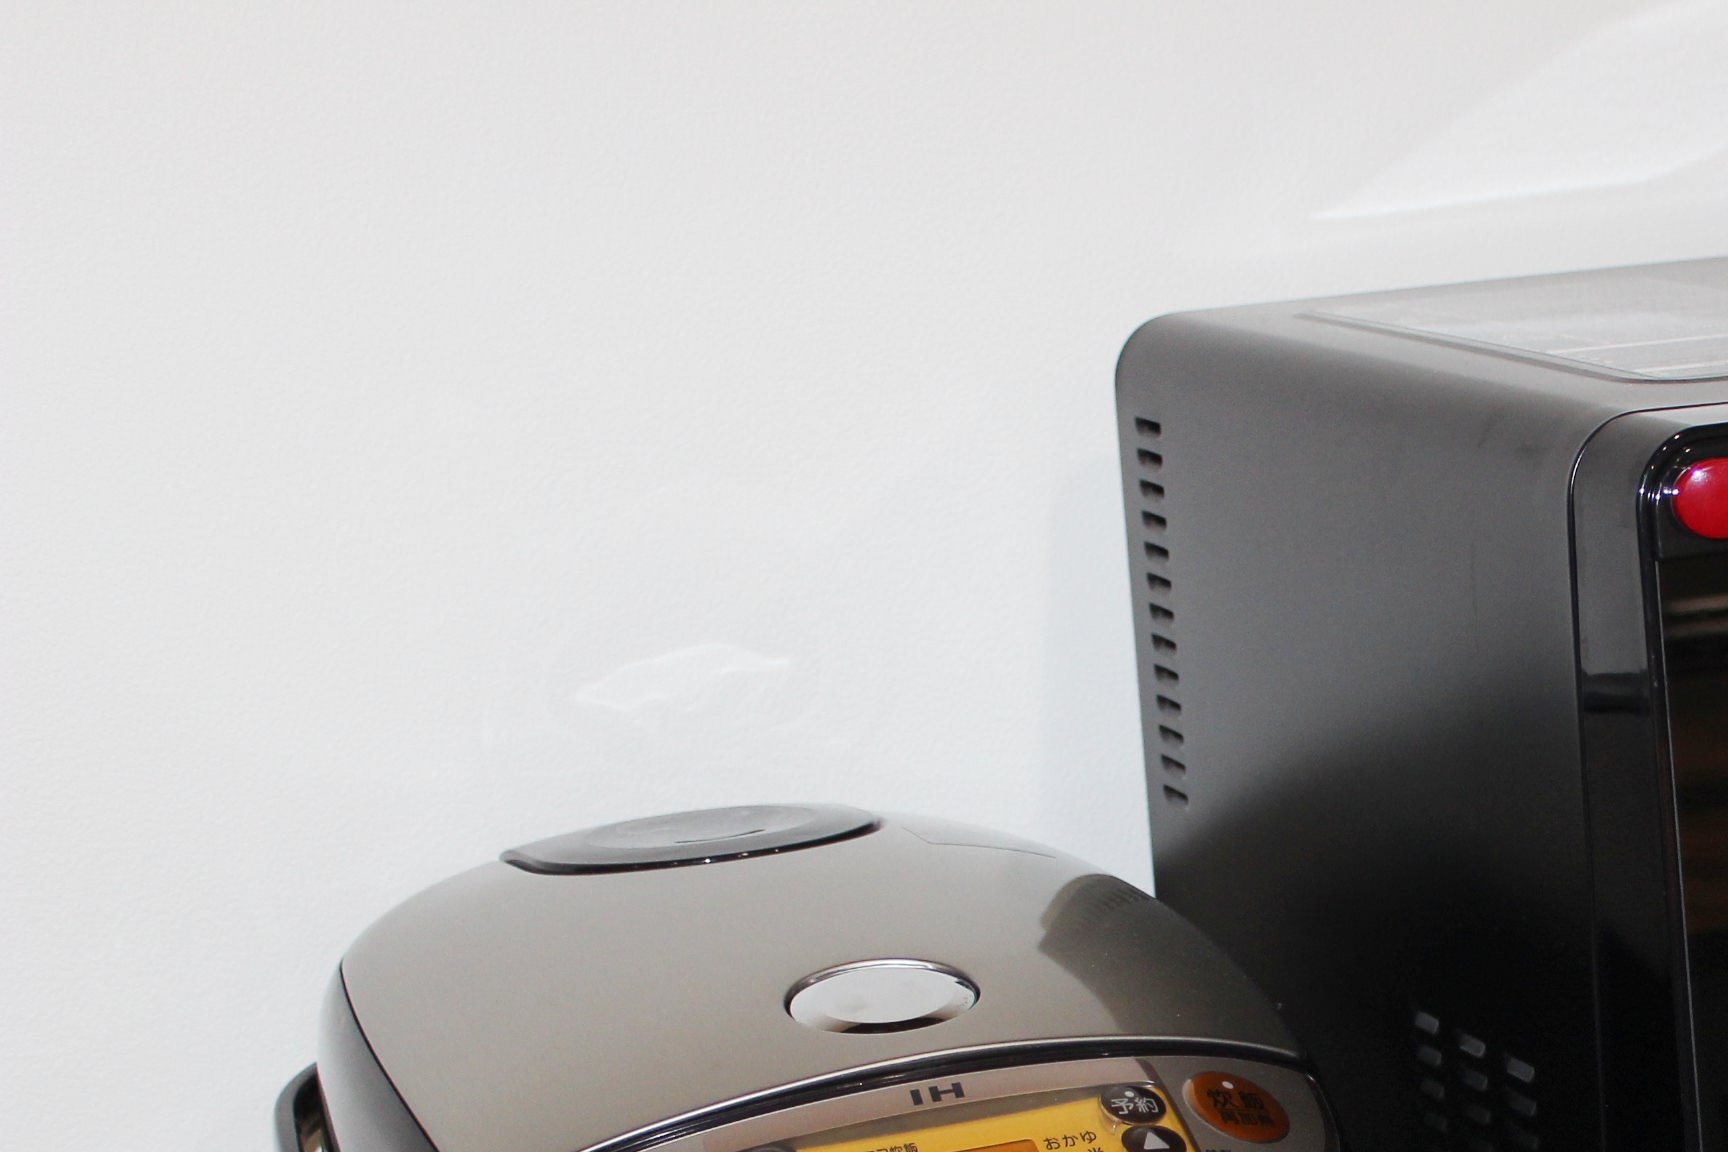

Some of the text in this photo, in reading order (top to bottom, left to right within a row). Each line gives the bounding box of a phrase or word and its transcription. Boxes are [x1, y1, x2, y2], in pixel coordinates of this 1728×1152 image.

[909, 1082, 966, 1106] IH
[1111, 1096, 1160, 1115] 予約
[1043, 1130, 1097, 1150] おかゆ
